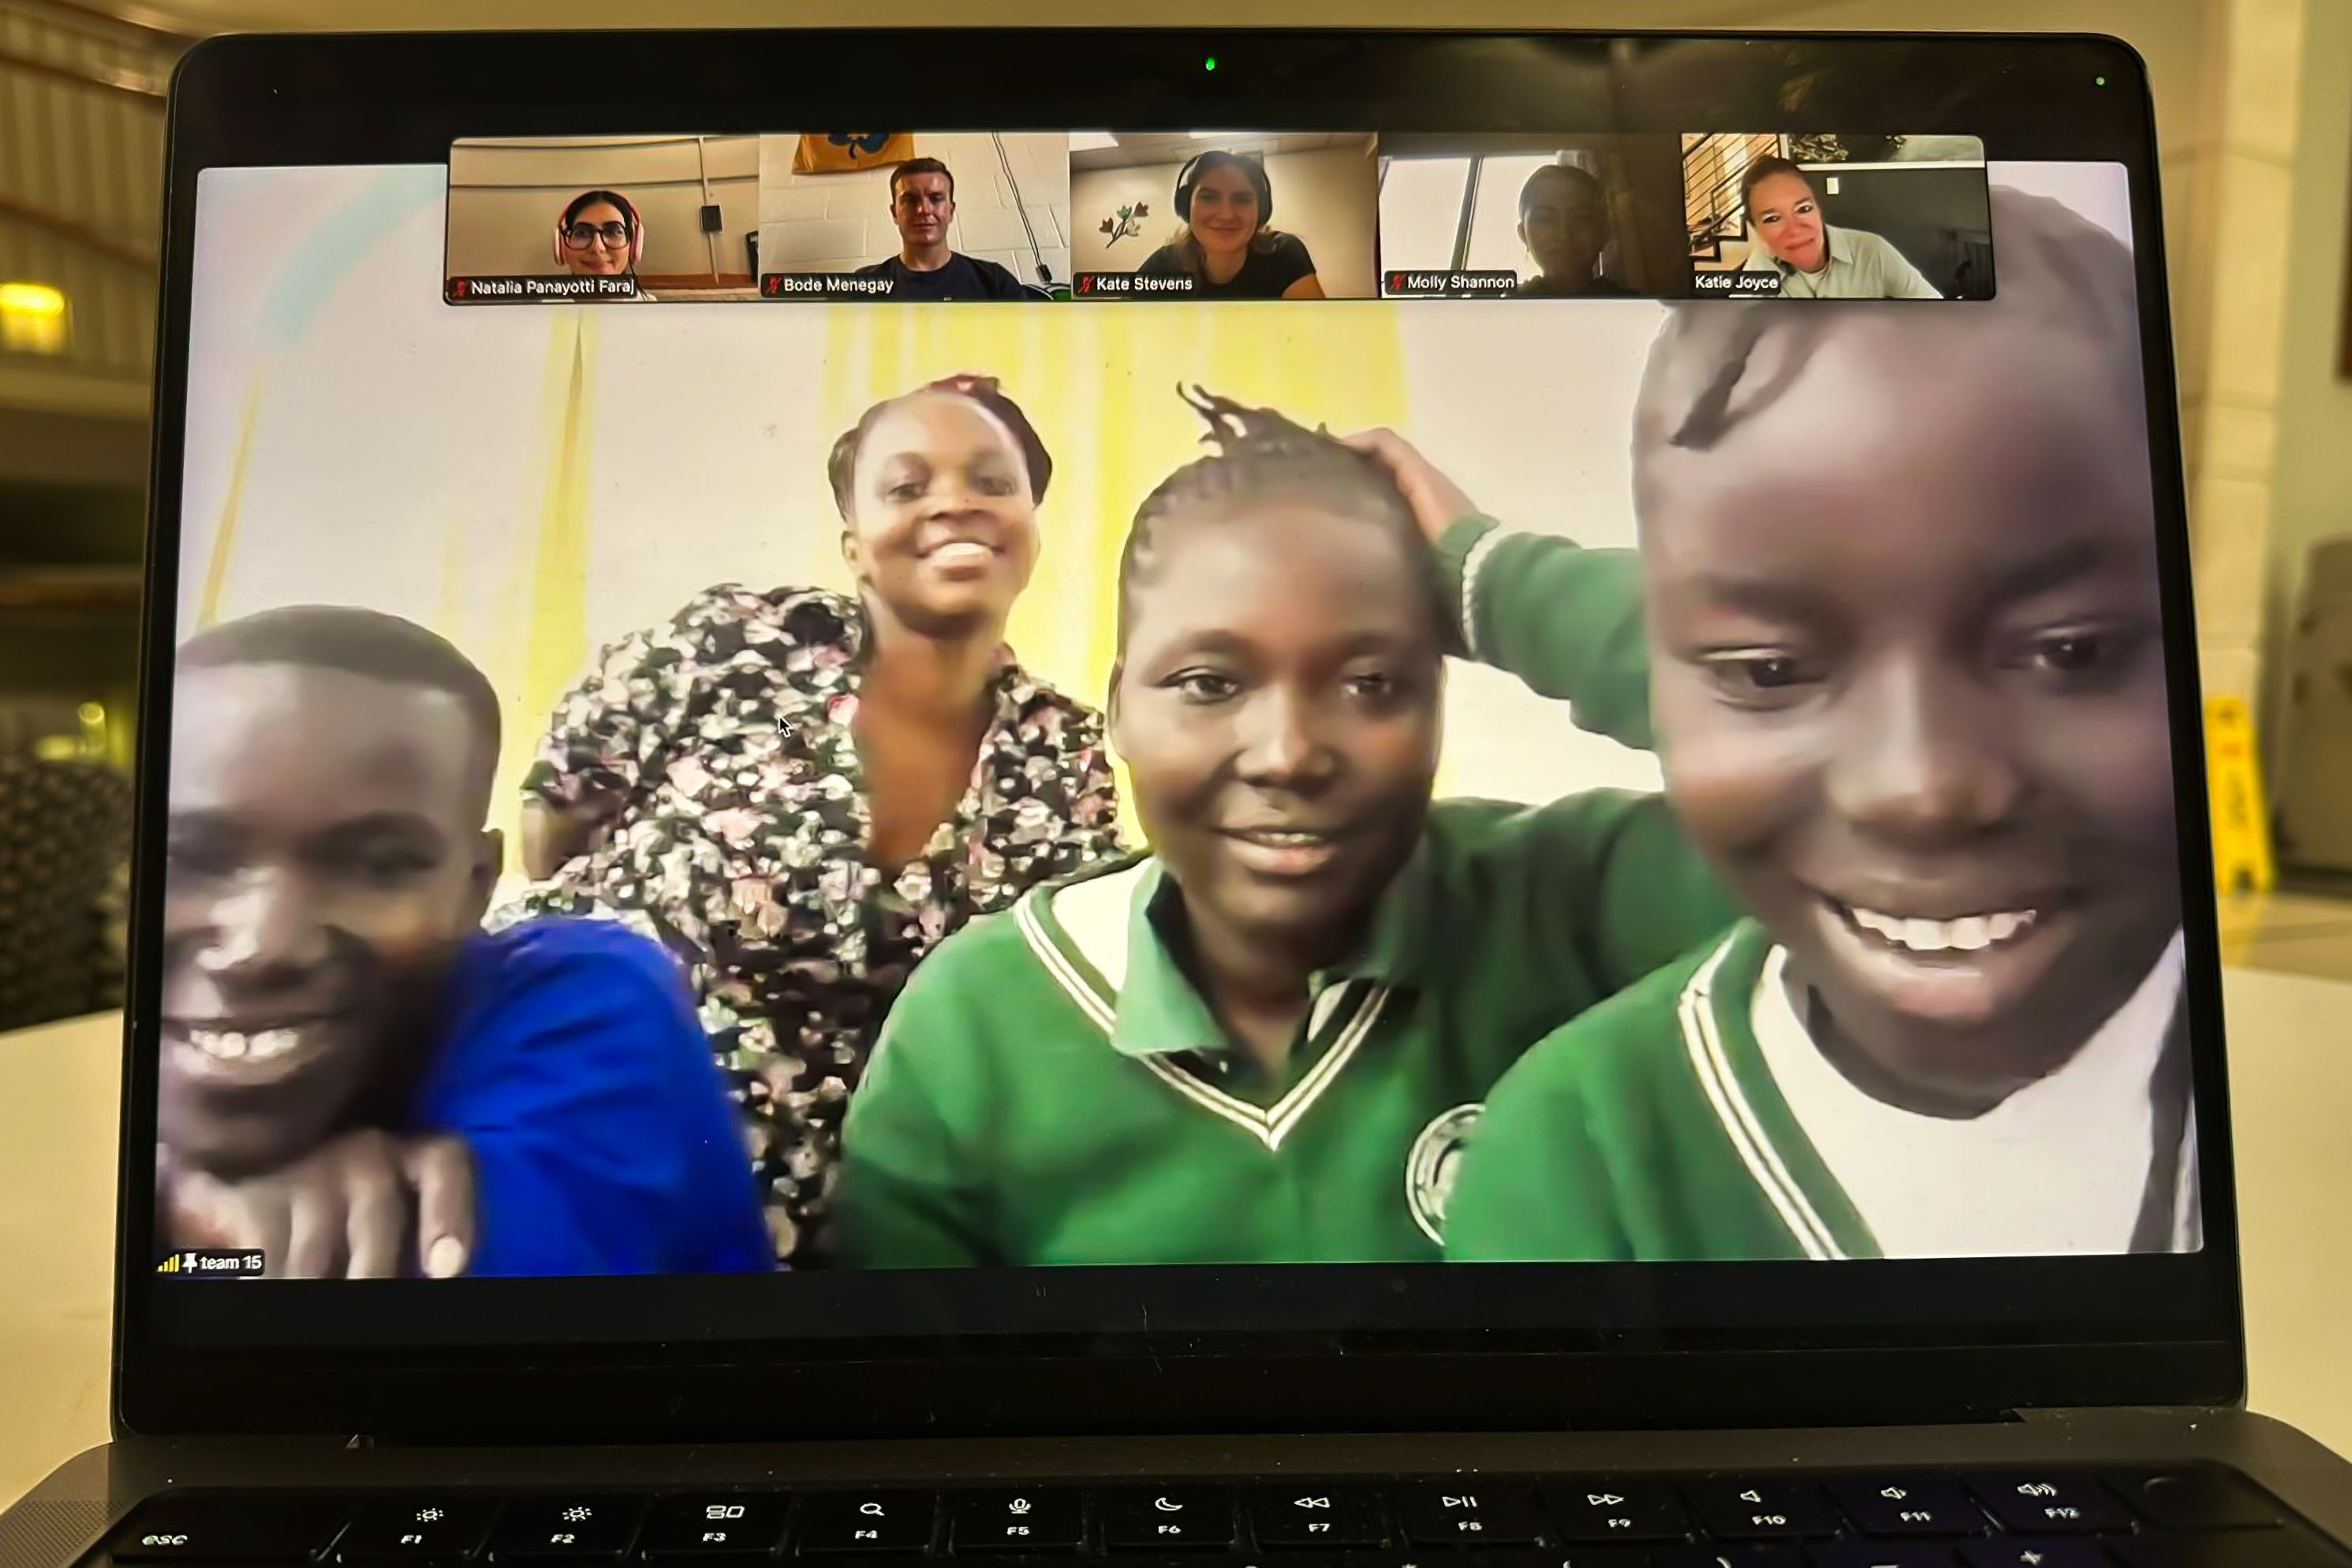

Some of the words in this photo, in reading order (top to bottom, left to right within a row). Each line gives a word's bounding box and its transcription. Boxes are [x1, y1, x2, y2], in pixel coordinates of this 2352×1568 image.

[471, 279, 522, 294] Natalia
[527, 279, 594, 296] Panayotti
[599, 279, 634, 295] Faraj
[784, 278, 823, 292] Bode
[827, 277, 894, 294] Menegay
[1096, 276, 1129, 290] Kate
[1134, 277, 1193, 290] Stevens
[1407, 276, 1447, 291] Molly
[1450, 275, 1514, 289] Shannon
[1695, 275, 1731, 289] Katie
[1735, 276, 1779, 291] Joyce
[199, 1256, 240, 1270] team
[241, 1255, 263, 1270] 15
[1607, 1518, 1631, 1529] F9
[1752, 1514, 1786, 1526] F10
[1006, 1526, 1030, 1536] F5
[1158, 1525, 1182, 1535] F6
[1308, 1523, 1331, 1533] F7
[141, 1534, 189, 1546] esc
[401, 1534, 423, 1544] F1
[551, 1533, 575, 1544] F2
[703, 1532, 726, 1543] F3
[854, 1529, 878, 1540] F4
